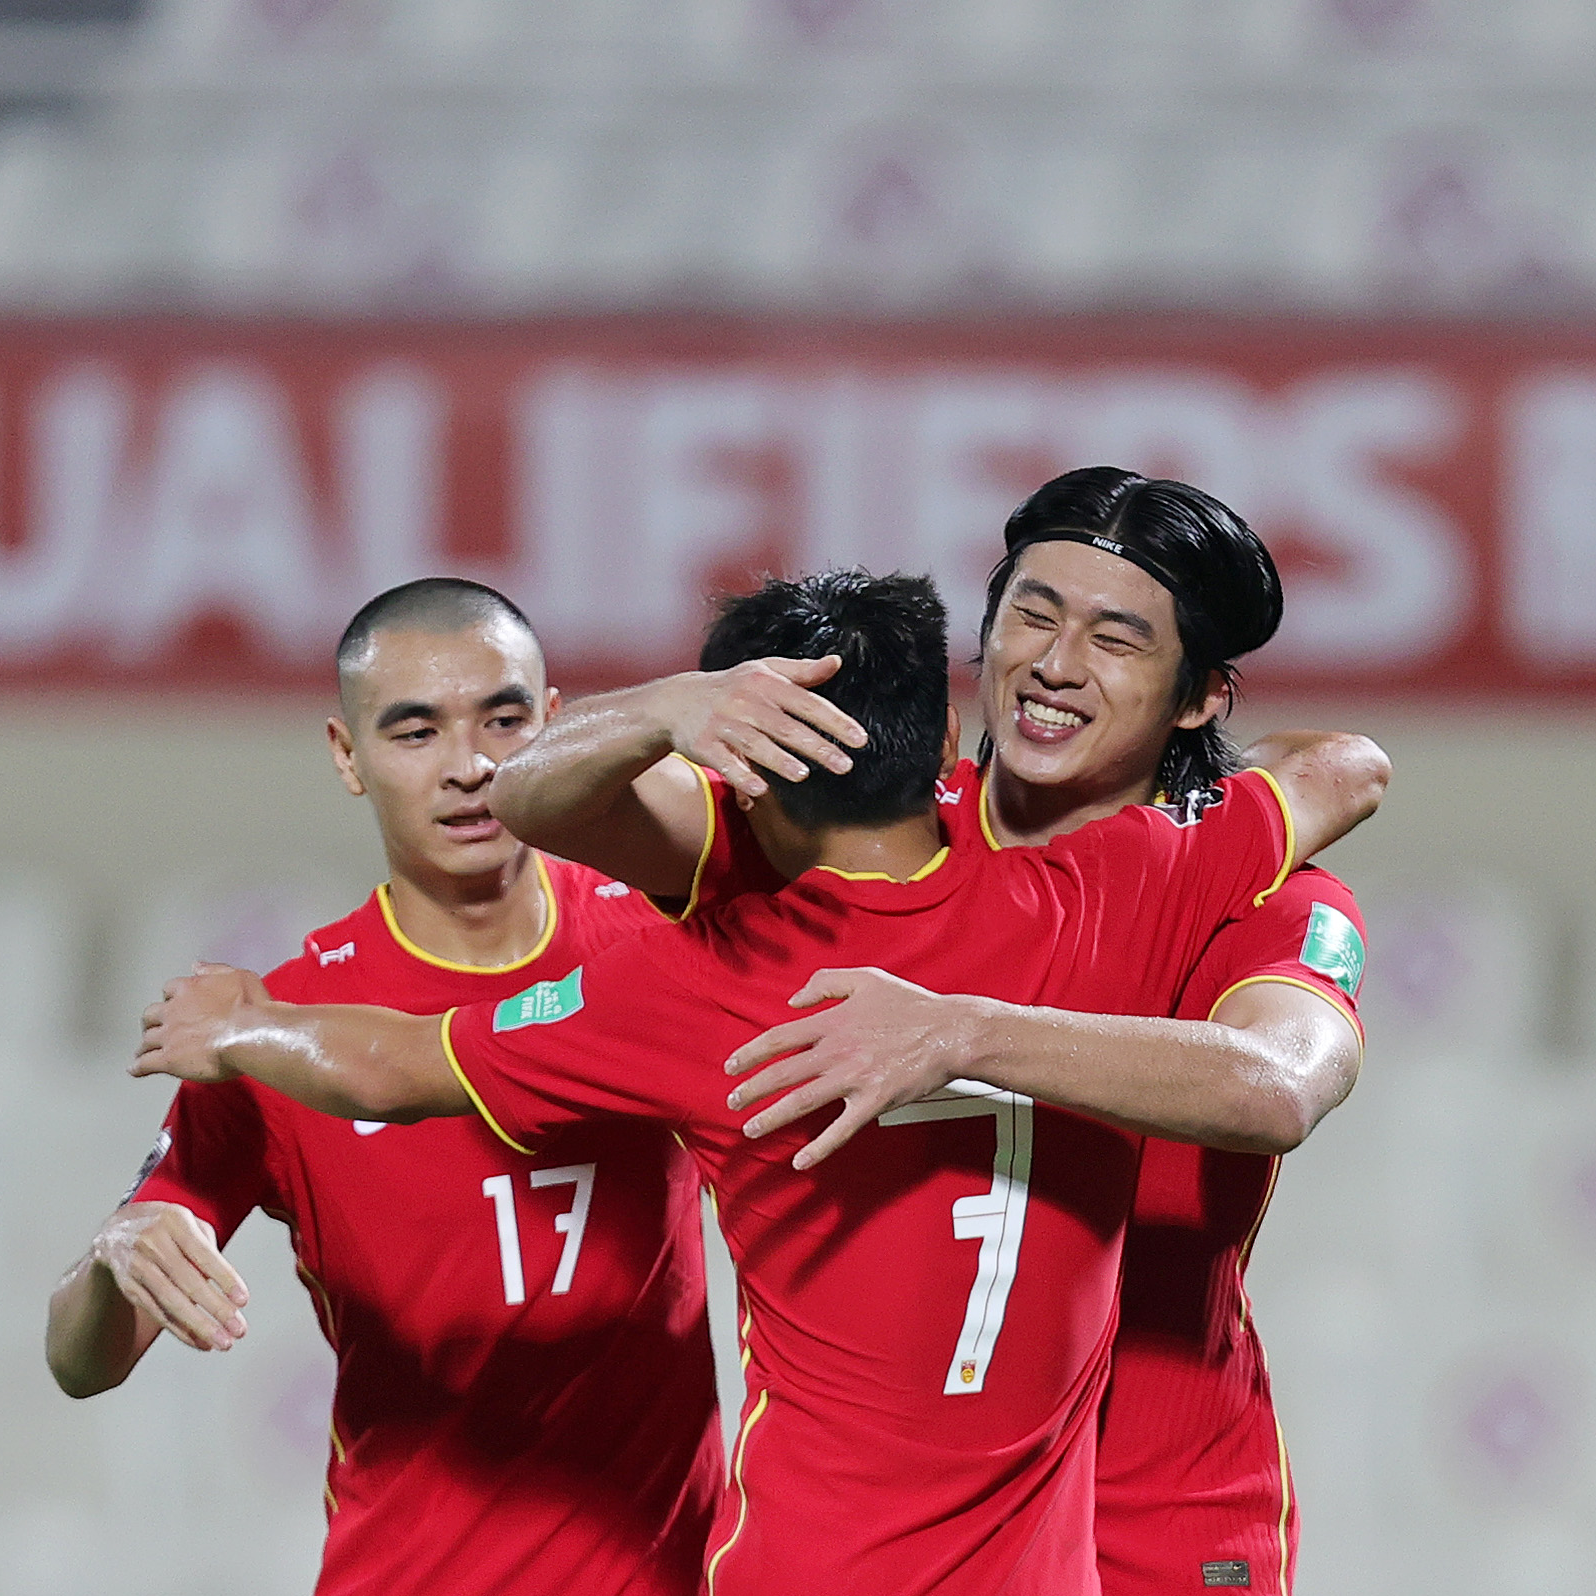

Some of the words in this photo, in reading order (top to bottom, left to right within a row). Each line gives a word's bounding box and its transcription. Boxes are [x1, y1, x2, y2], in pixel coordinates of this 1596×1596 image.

[1092, 536, 1125, 554] NIKE
[482, 1163, 596, 1305] 17
[878, 1079, 1034, 1395] 7
